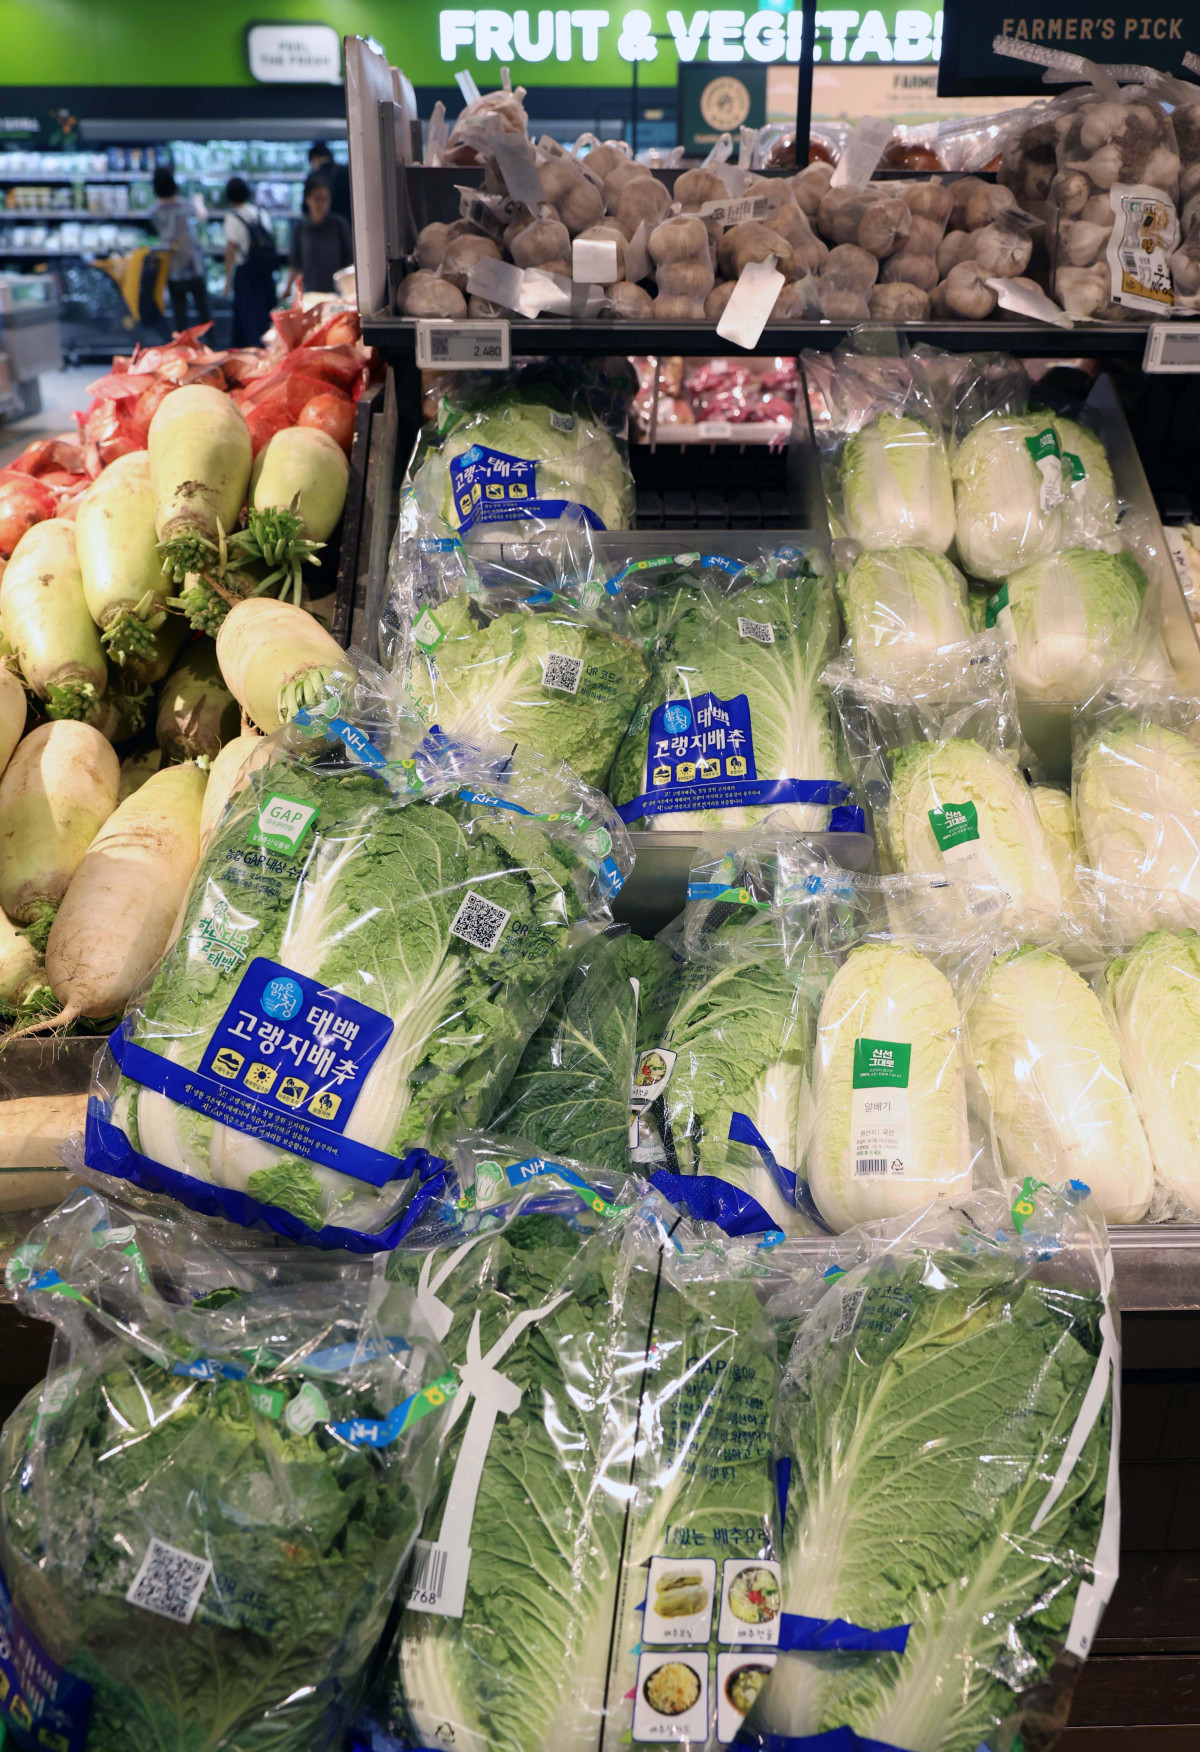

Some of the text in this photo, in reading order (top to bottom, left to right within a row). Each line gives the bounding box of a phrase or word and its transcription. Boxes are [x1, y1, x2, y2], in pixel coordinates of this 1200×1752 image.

[439, 10, 610, 62] FRUIT
[618, 9, 658, 62] &
[1002, 18, 1183, 40] FARMER'S PICK
[894, 75, 938, 91] FARME
[585, 665, 598, 677] QR
[697, 706, 731, 728] 태백
[341, 727, 365, 752] NH
[653, 728, 746, 759] 고랭지배추
[472, 792, 499, 806] NH
[270, 805, 302, 825] GAP
[243, 850, 266, 868] GAP
[265, 857, 286, 874] 대상
[510, 919, 529, 936] QR
[206, 951, 237, 972] 태백
[306, 1006, 360, 1051] 태백
[227, 1010, 359, 1086] 고랭지배추
[873, 1048, 893, 1059] 신선
[869, 1058, 895, 1068] 그대로
[864, 1101, 891, 1113] 알배기
[521, 1159, 544, 1178] NH
[685, 1356, 726, 1374] GAP
[738, 1629, 772, 1640] 배추전골
